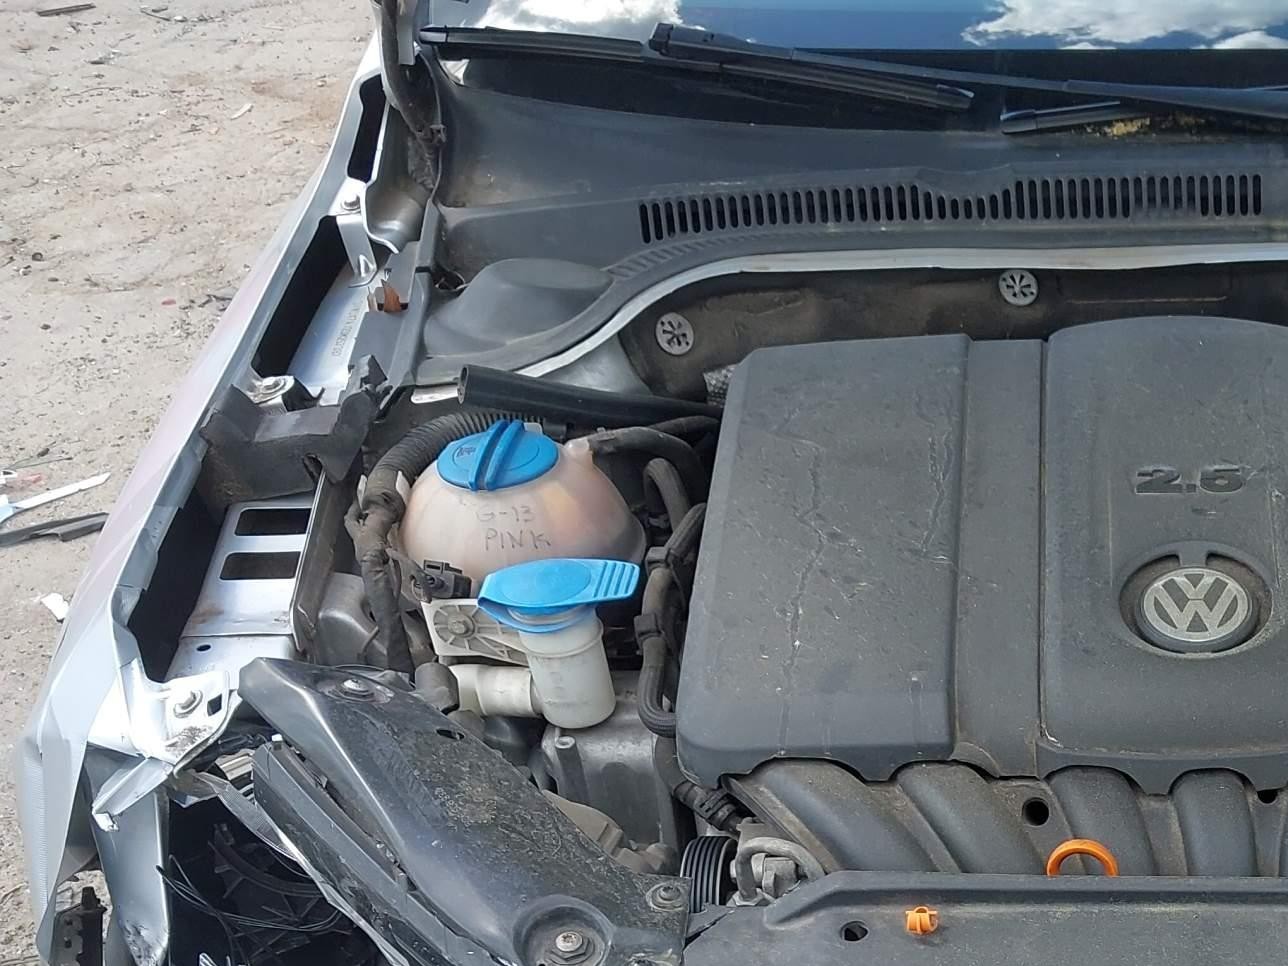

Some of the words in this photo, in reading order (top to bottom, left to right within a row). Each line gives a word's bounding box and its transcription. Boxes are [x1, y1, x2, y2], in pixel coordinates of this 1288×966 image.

[1135, 466, 1243, 494] 2.5
[485, 527, 551, 551] PINK
[1145, 569, 1246, 638] VW
